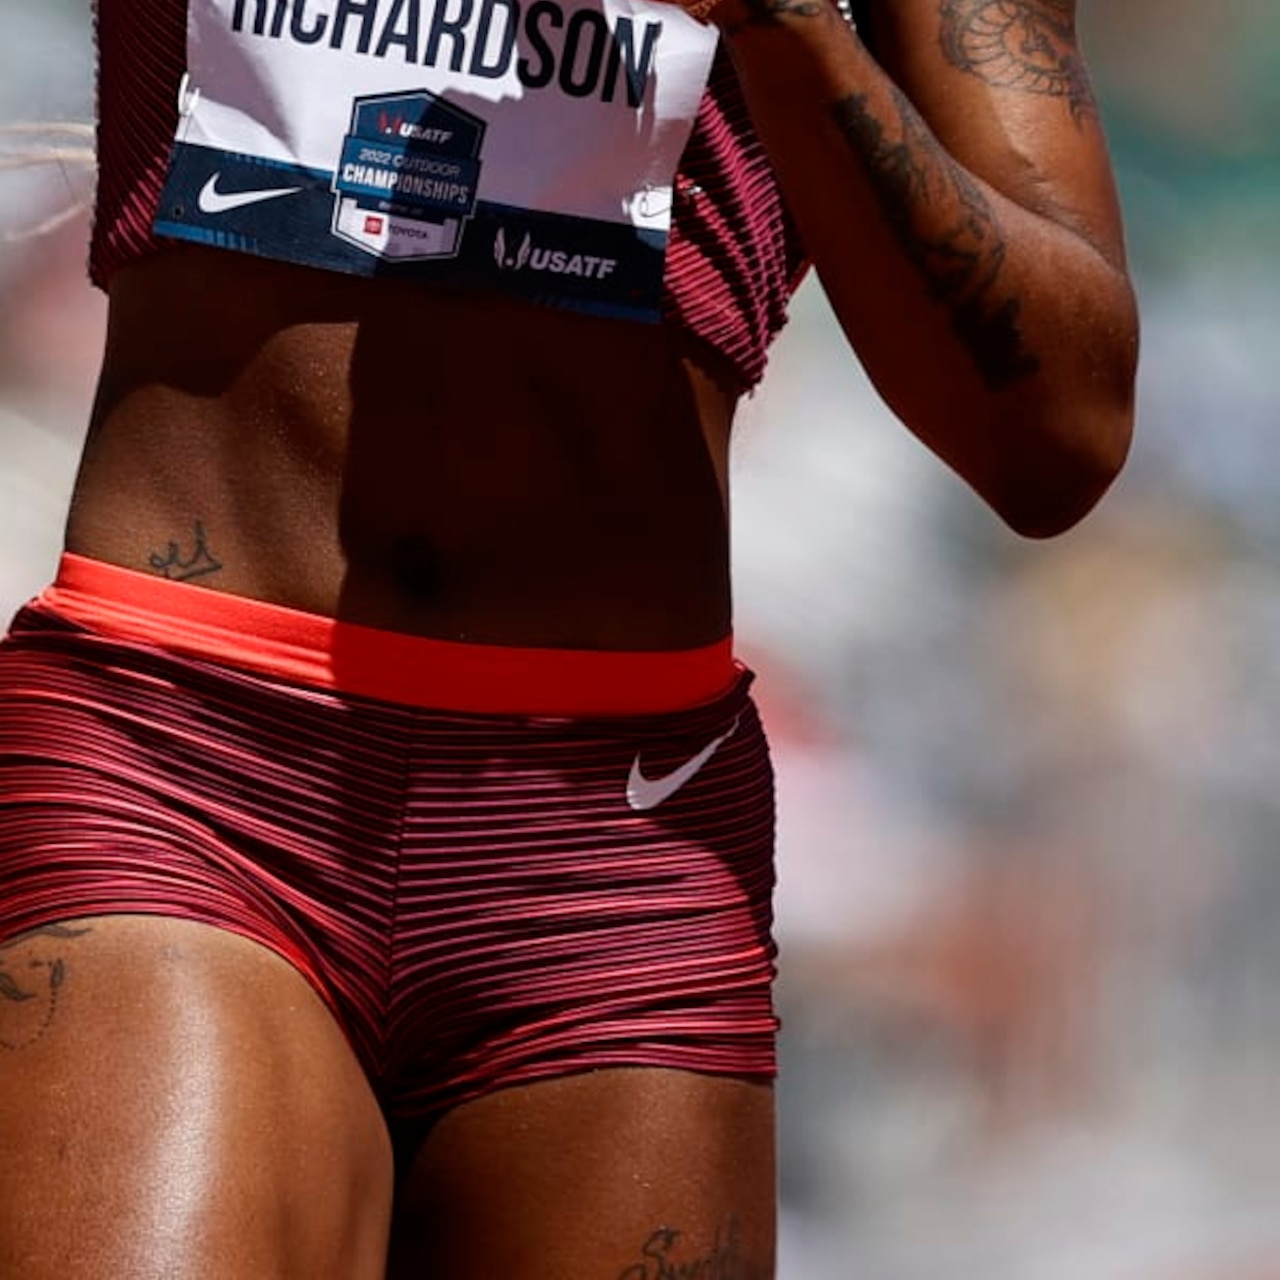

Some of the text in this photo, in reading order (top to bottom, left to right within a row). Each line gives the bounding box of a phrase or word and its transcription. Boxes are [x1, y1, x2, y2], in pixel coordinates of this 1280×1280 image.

[399, 123, 454, 144] USATF
[358, 148, 461, 177] 2022 OUTDOOR
[342, 163, 469, 204] CHAMPIONSHIPS
[529, 248, 617, 279] USATF
